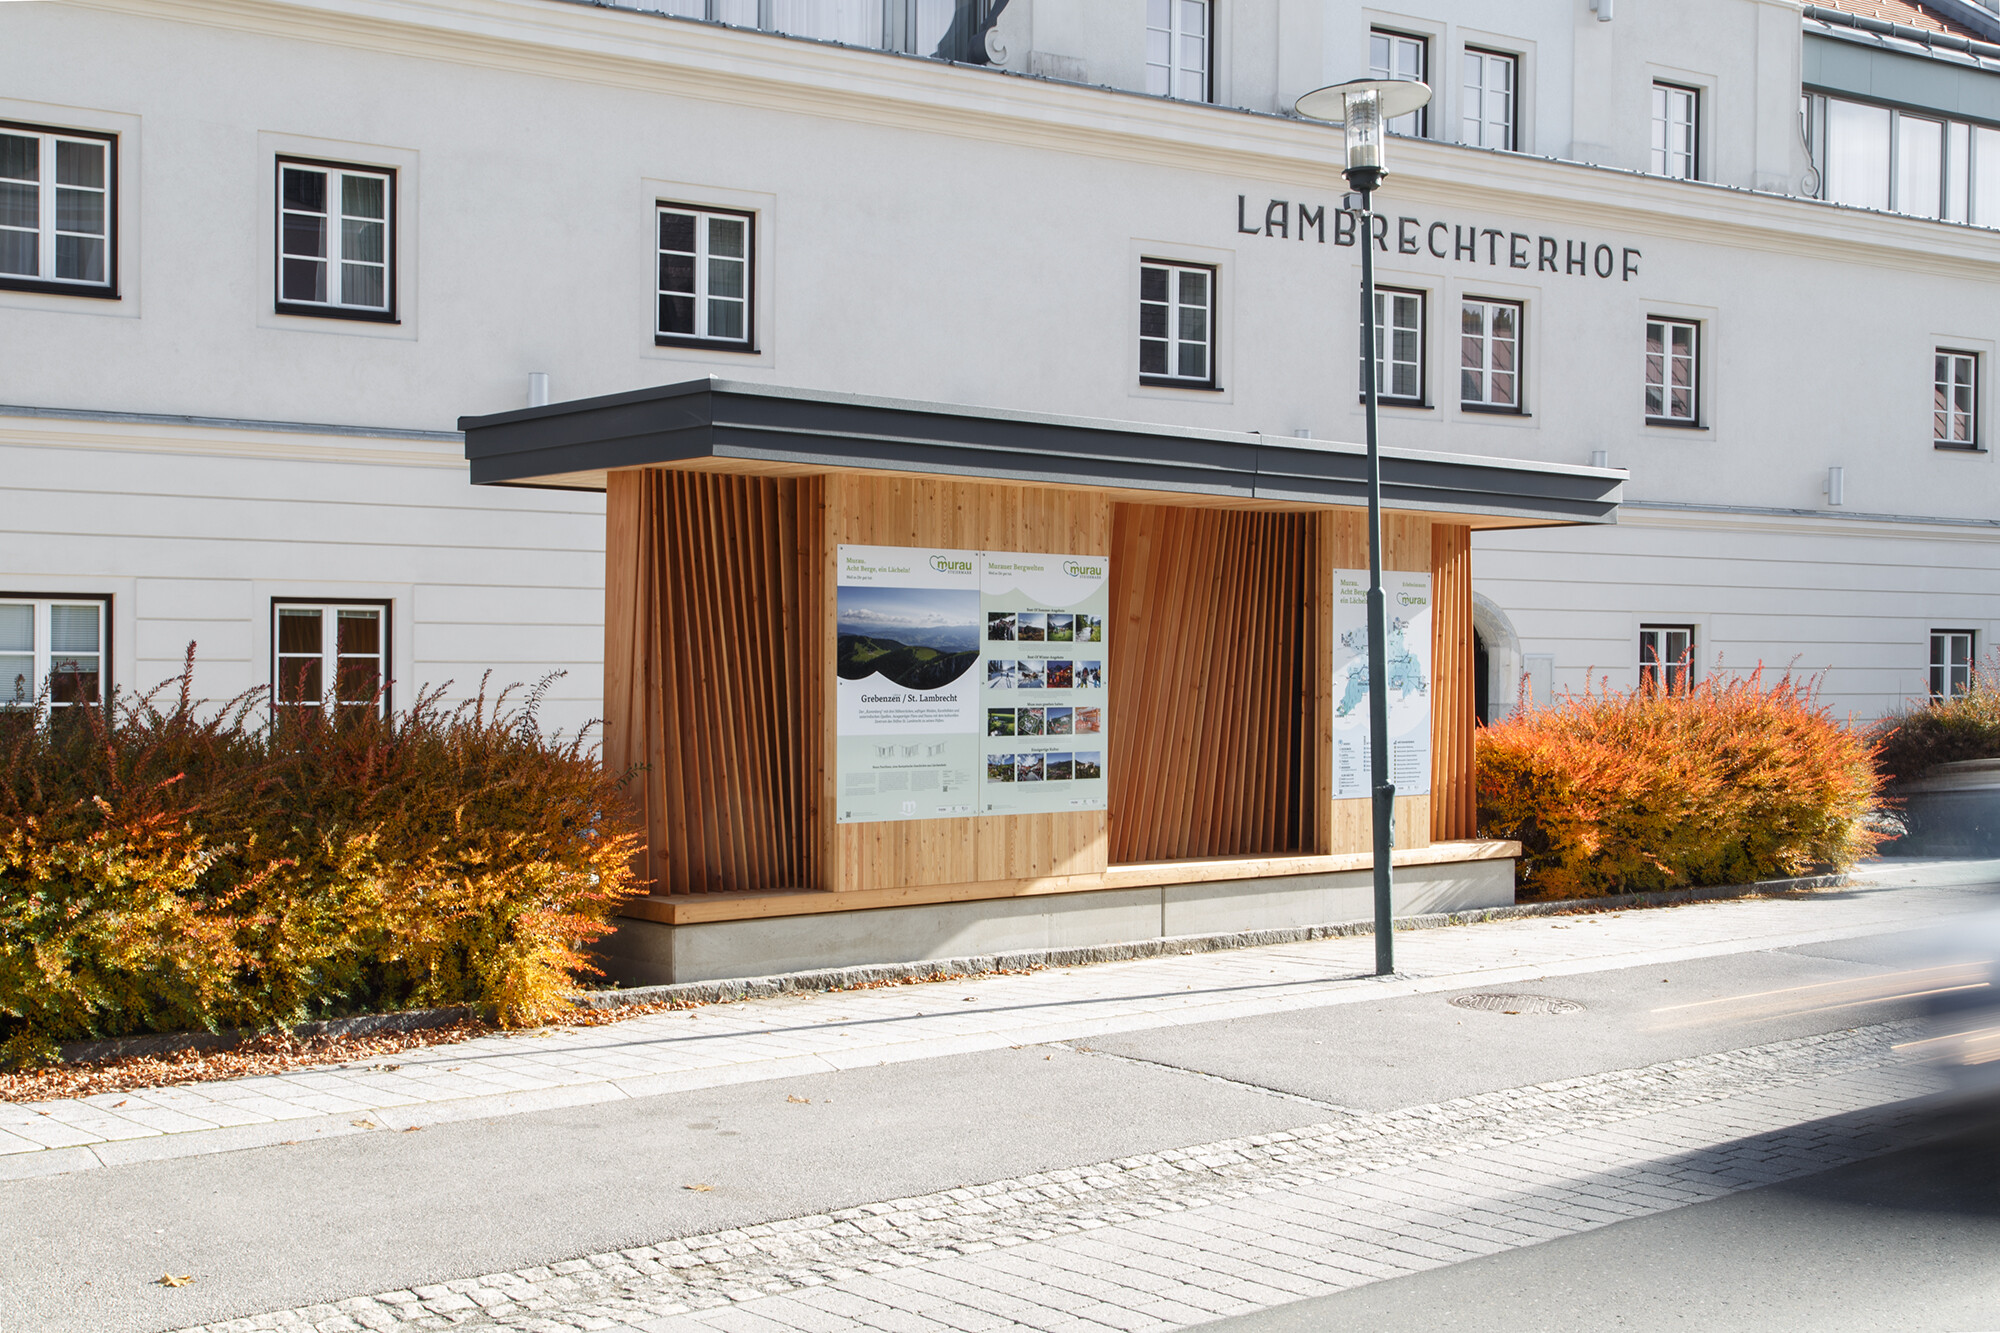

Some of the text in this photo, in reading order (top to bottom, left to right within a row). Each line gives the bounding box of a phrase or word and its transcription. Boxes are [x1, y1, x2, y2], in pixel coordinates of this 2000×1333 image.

[1238, 194, 1642, 282] LAMBRECHTERHOF
[937, 560, 972, 570] murau
[1013, 564, 1044, 572] Bergwelten
[1070, 566, 1102, 575] murau
[1401, 595, 1426, 605] murau
[861, 694, 901, 703] Grebenzen
[907, 694, 918, 703] St.
[919, 694, 957, 702] Lambrecht
